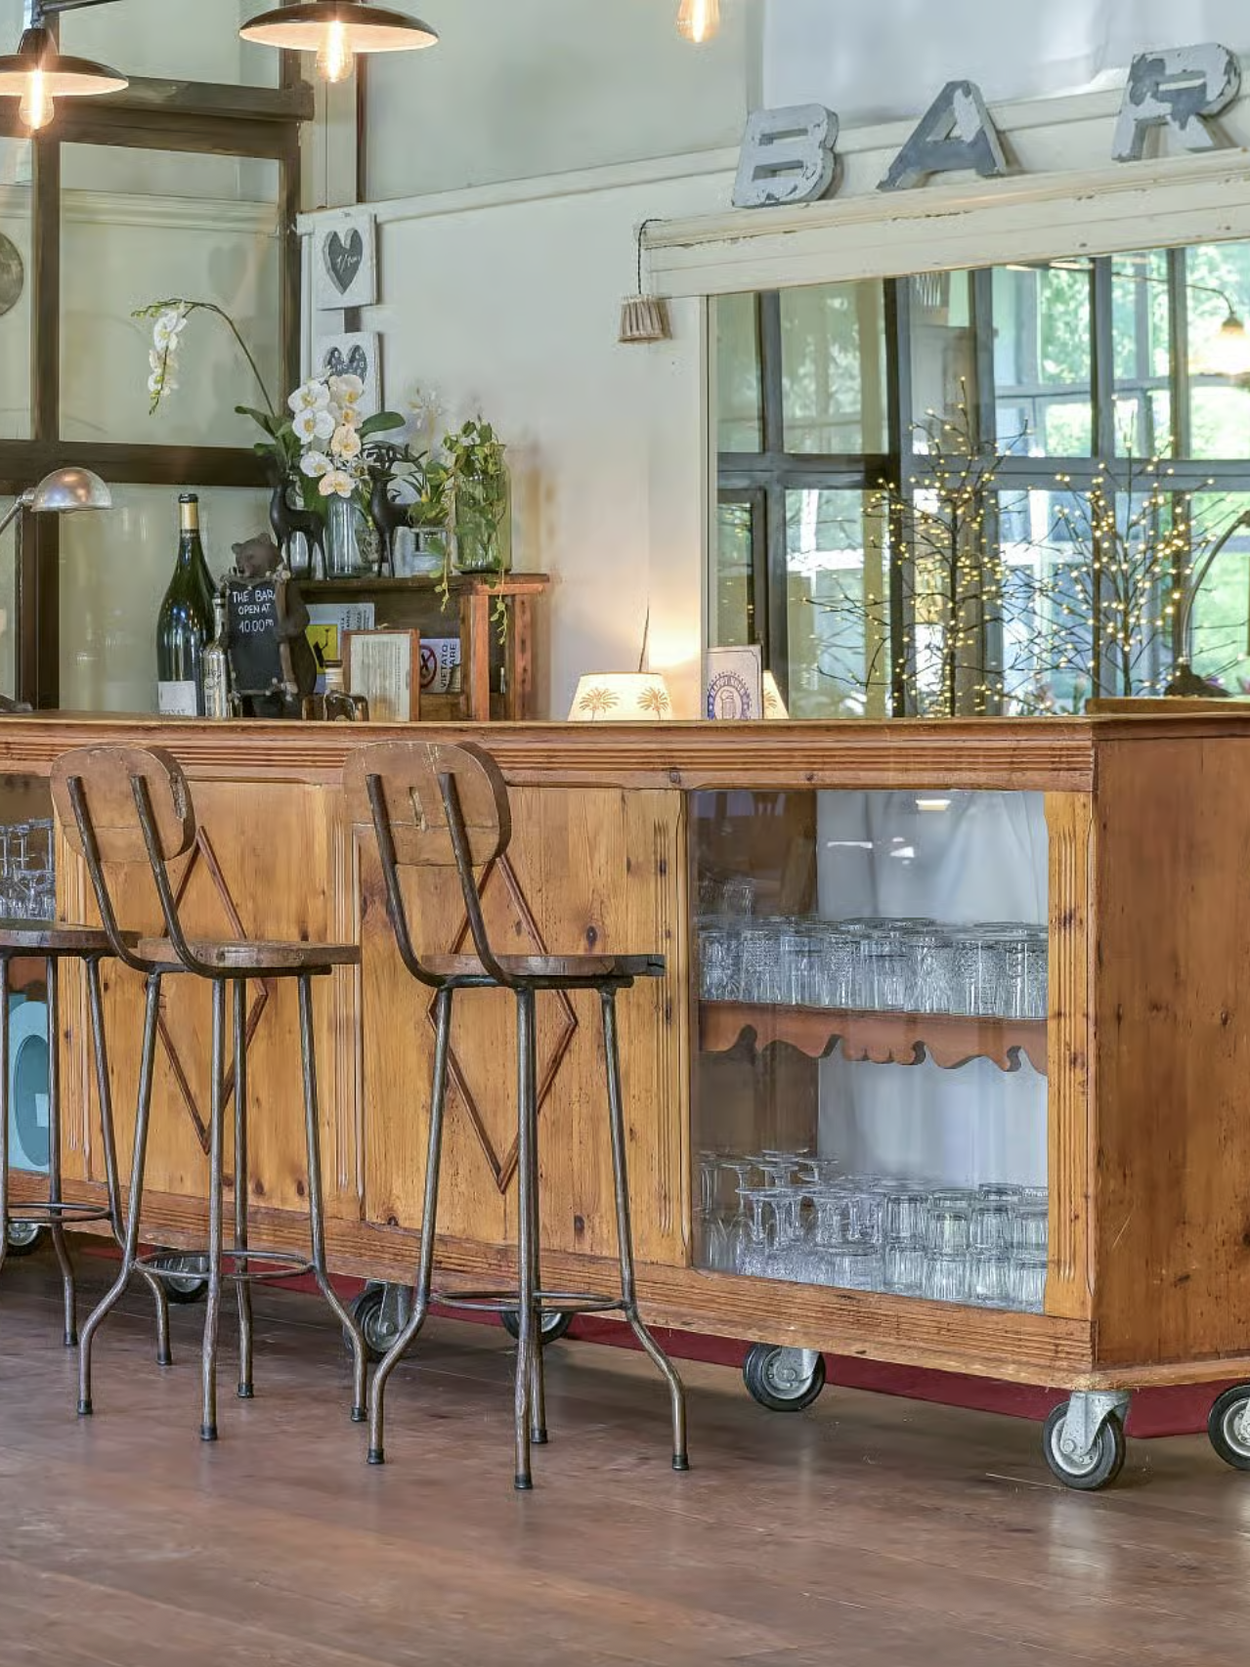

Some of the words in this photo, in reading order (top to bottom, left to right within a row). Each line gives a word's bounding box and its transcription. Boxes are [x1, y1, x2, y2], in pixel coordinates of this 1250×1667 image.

[732, 42, 1241, 208] BAR
[232, 590, 249, 603] THE
[238, 604, 259, 615] OPEN
[261, 603, 271, 612] AT
